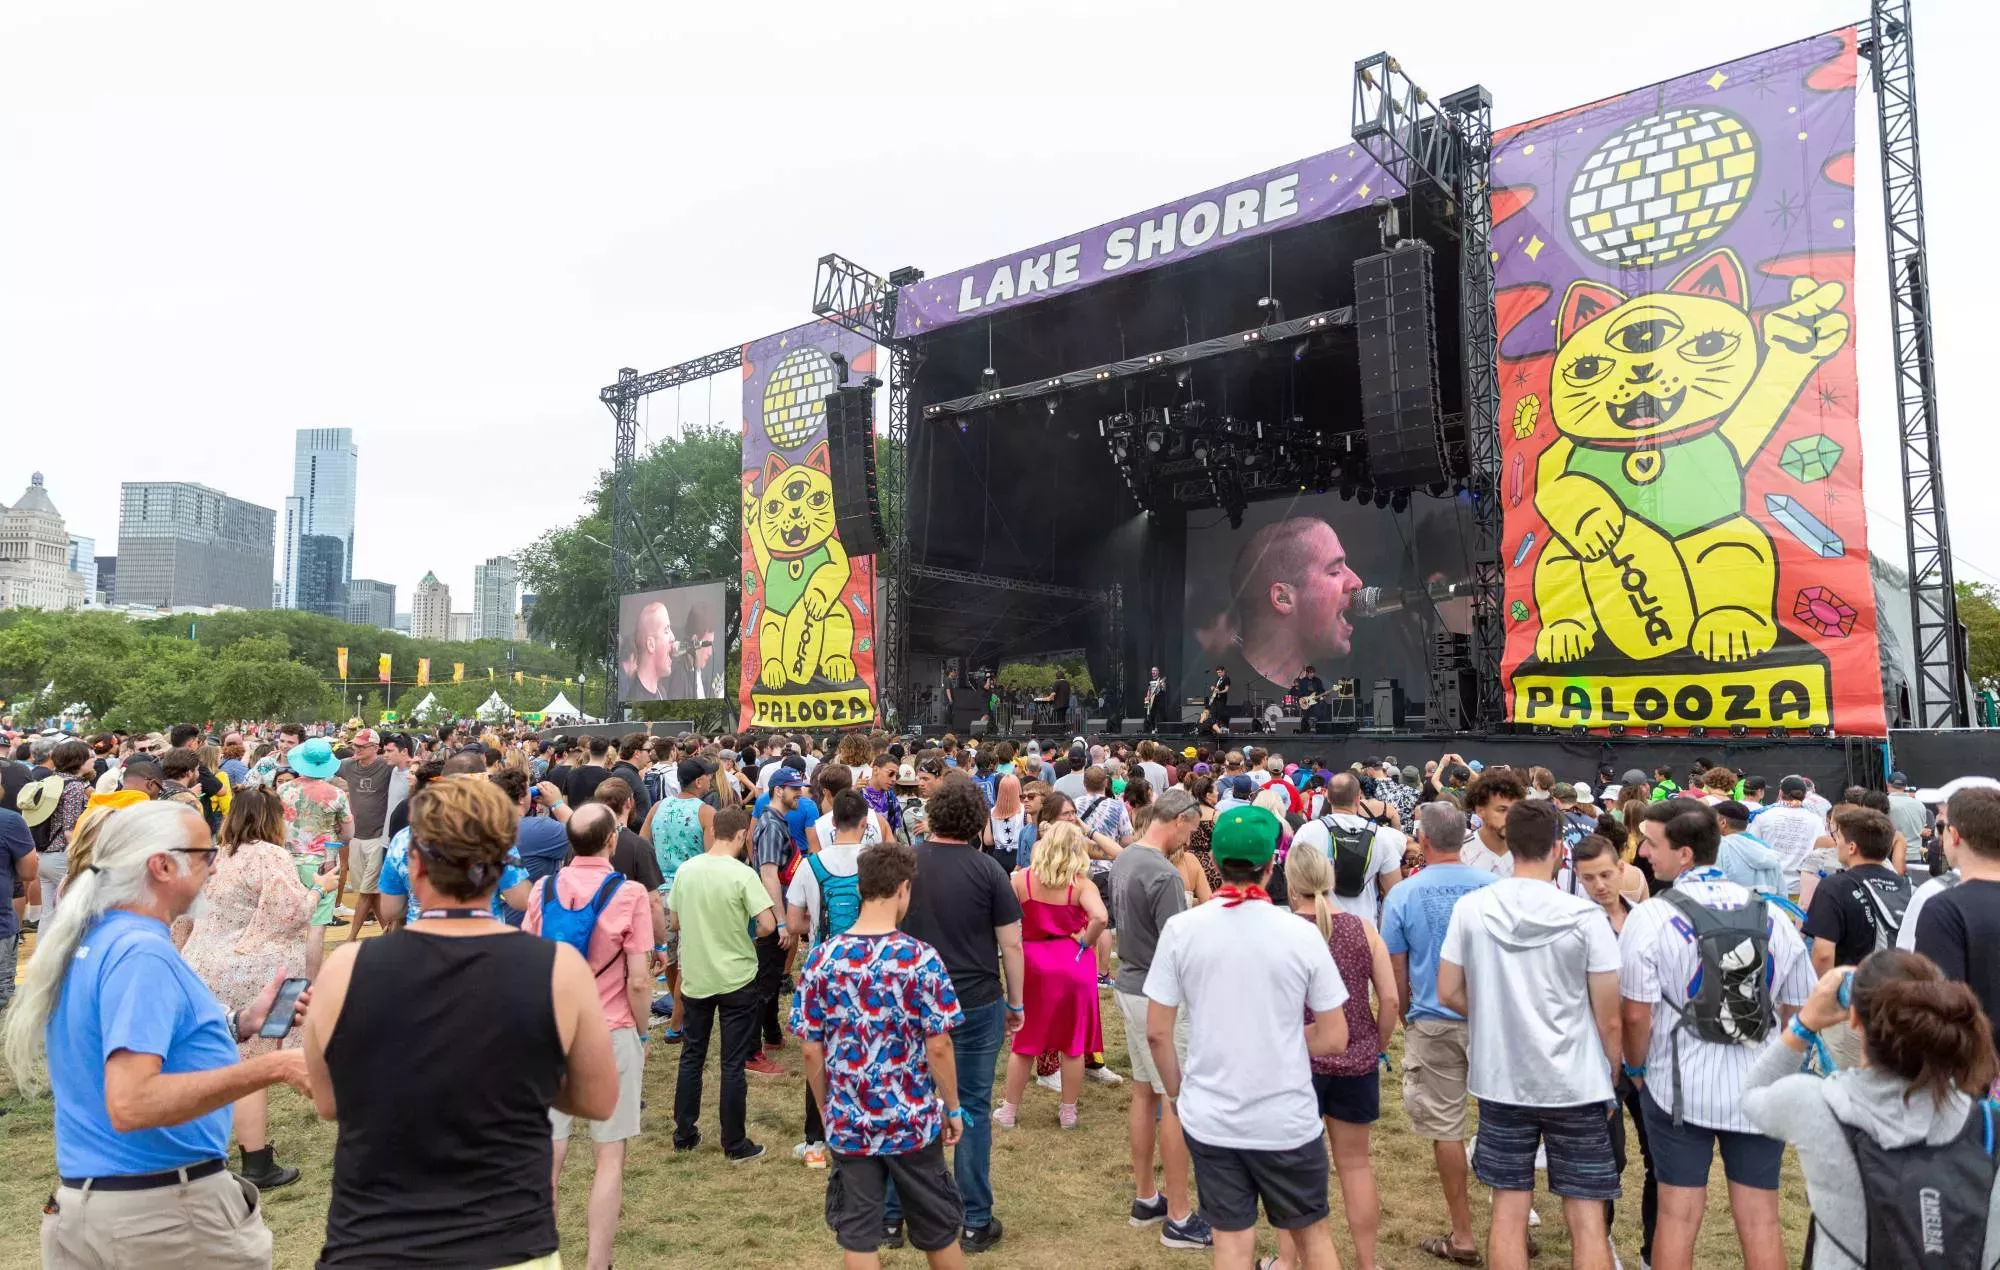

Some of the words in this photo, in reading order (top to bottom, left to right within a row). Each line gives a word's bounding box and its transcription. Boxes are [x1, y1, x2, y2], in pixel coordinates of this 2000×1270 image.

[956, 243, 1082, 312] LAKE
[1103, 172, 1300, 271] SHORE
[1609, 549, 1673, 646] LOLLA
[793, 612, 813, 676] LOLLA
[758, 698, 867, 722] PALOOZA
[1527, 680, 1810, 720] PALOOZA
[1919, 1187, 1945, 1255] CAMELBAK
